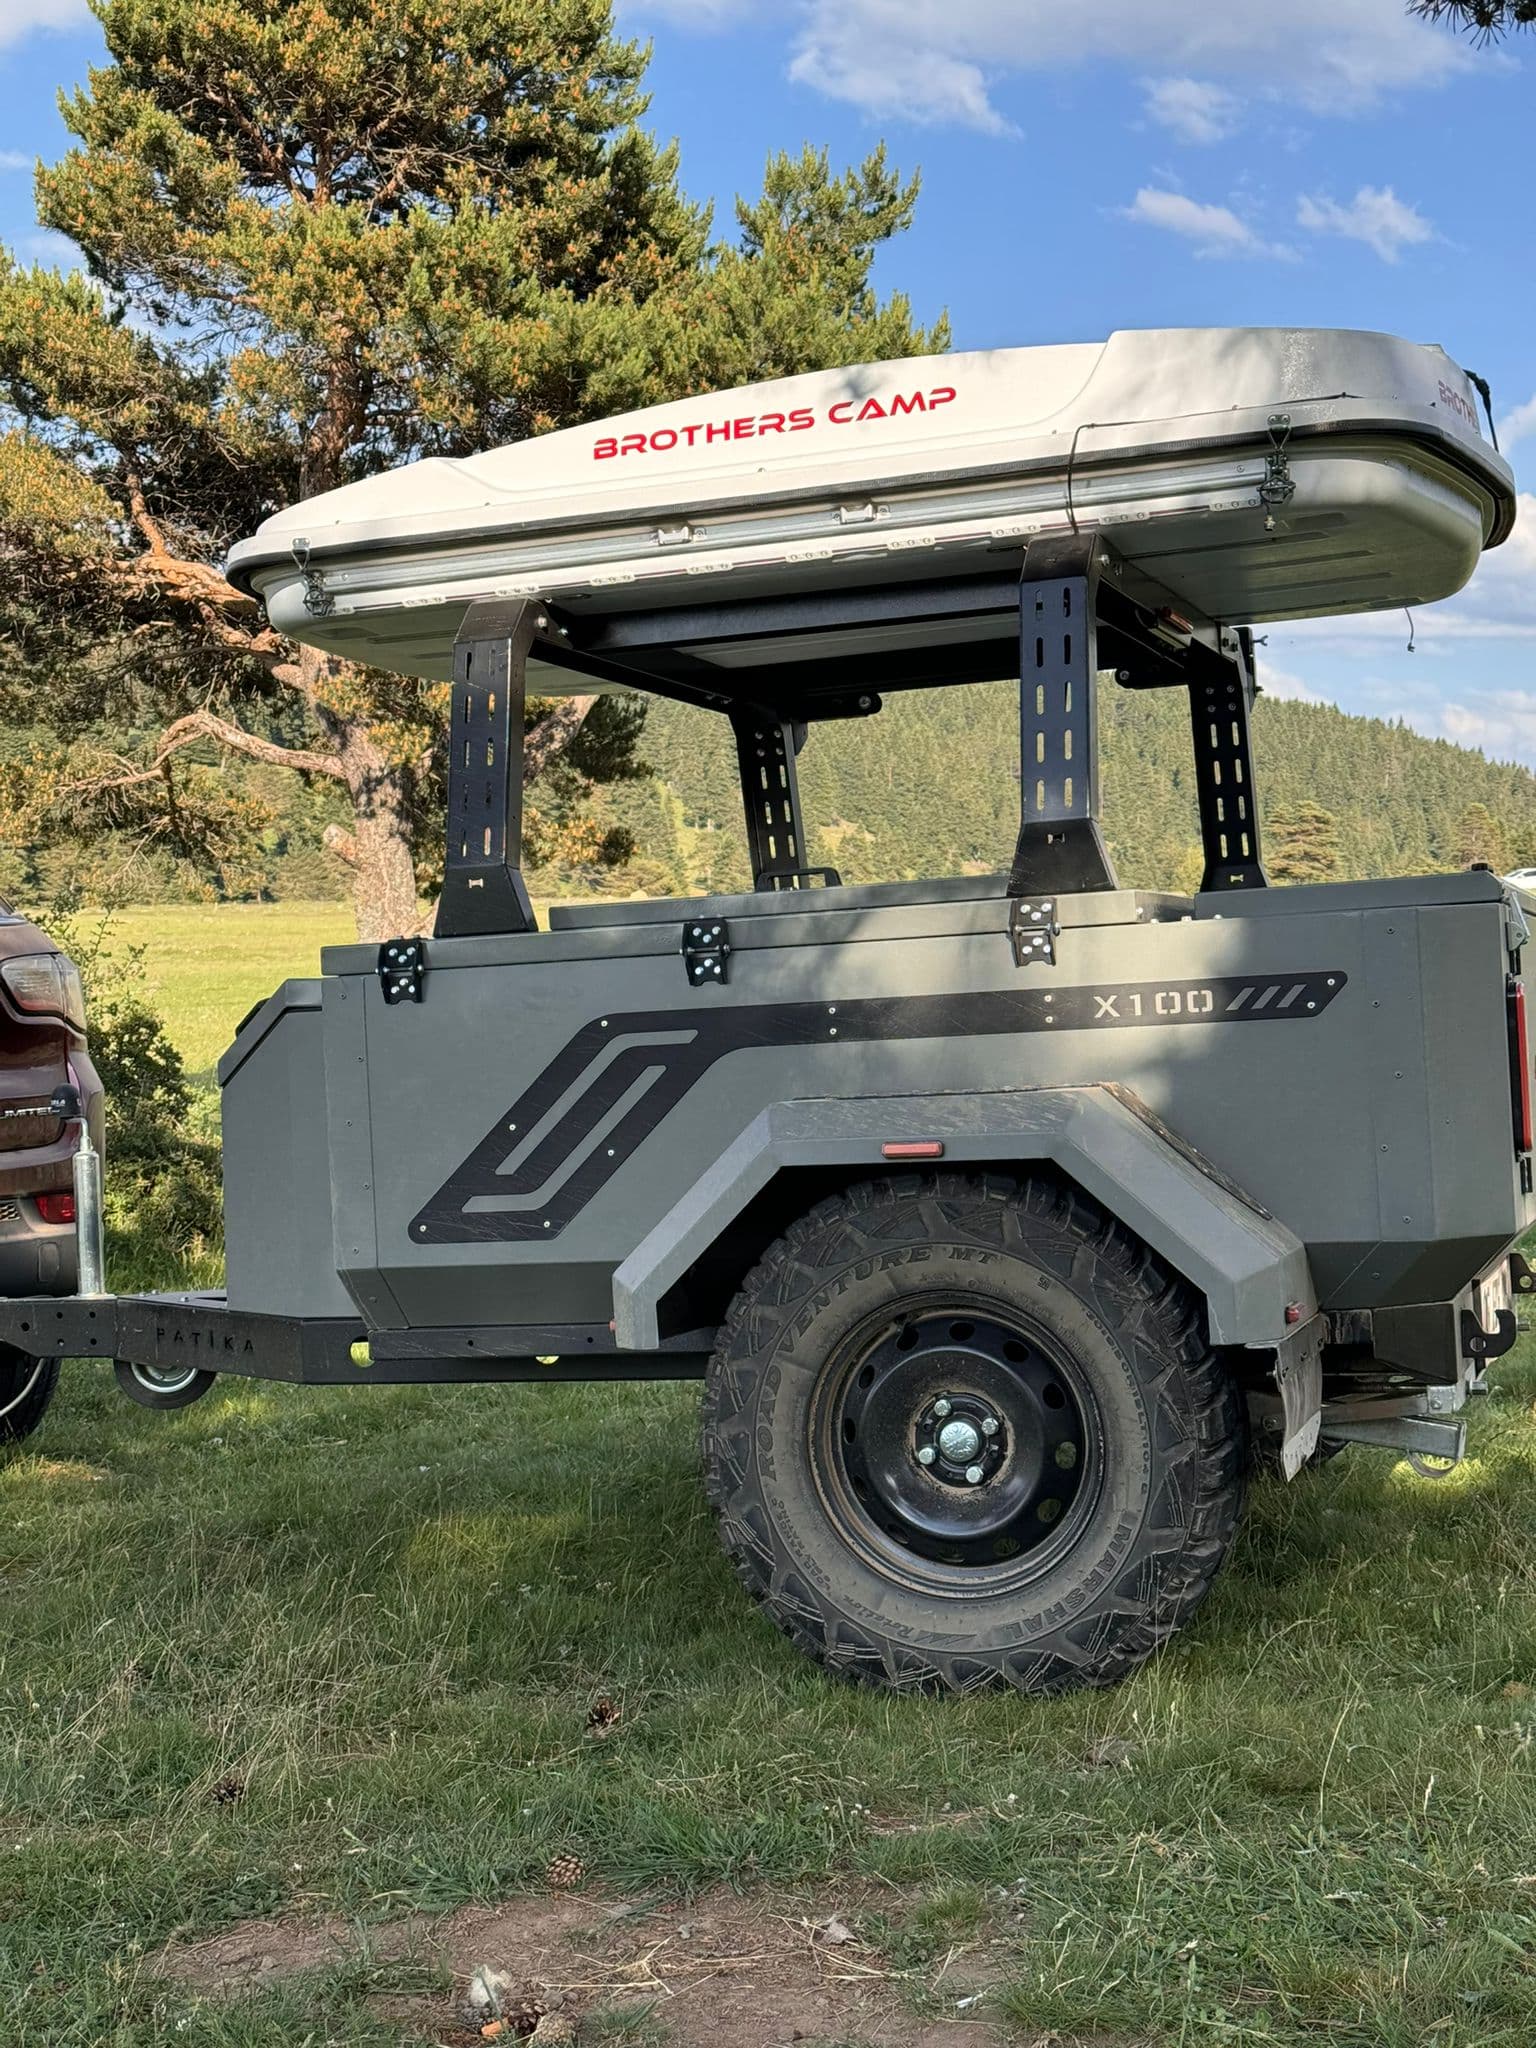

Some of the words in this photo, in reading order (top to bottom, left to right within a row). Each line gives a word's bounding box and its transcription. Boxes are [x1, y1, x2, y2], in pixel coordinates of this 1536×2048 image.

[594, 407, 815, 460] BROTHERS
[828, 387, 957, 424] CAMP
[1093, 990, 1213, 1018] X100
[756, 1364, 782, 1482] ROAD
[774, 1246, 934, 1354] VENTURE
[948, 1247, 997, 1265] MT
[1005, 1523, 1133, 1640] MARSHAL
